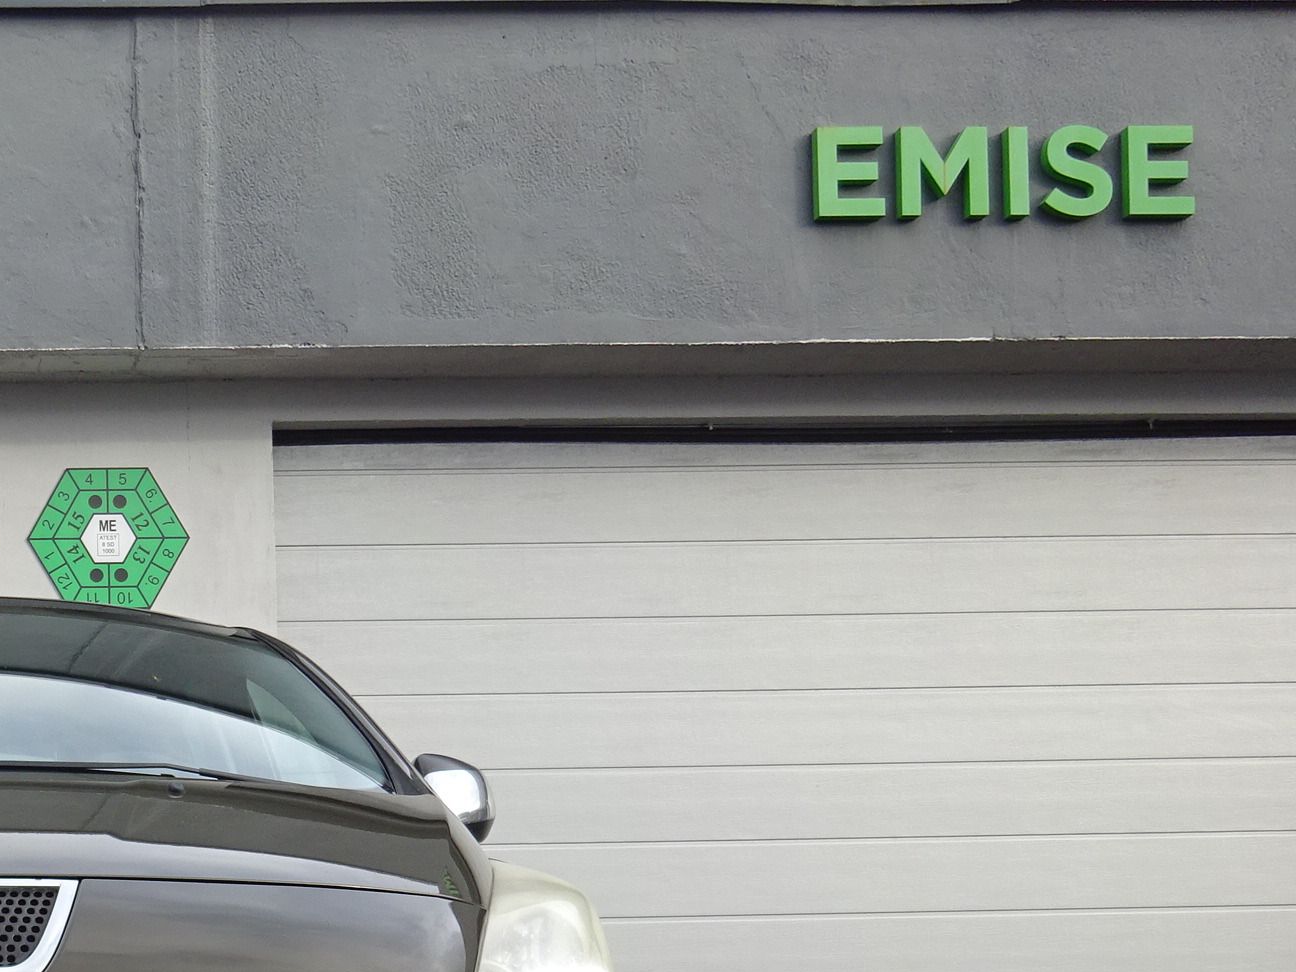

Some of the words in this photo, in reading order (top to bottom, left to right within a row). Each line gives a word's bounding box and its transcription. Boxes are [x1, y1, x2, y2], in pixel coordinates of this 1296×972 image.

[811, 124, 1196, 222] EMISE
[85, 473, 94, 485] 4
[118, 473, 127, 485] 5
[57, 491, 70, 502] 3
[42, 519, 55, 530] 2
[67, 511, 85, 531] 15
[99, 519, 117, 532] ME
[131, 512, 150, 531] 12
[162, 516, 175, 526] 7
[67, 543, 86, 564] 14
[133, 544, 150, 564] 13
[162, 548, 174, 559] 8
[56, 572, 73, 591] 12
[117, 591, 134, 605] 10
